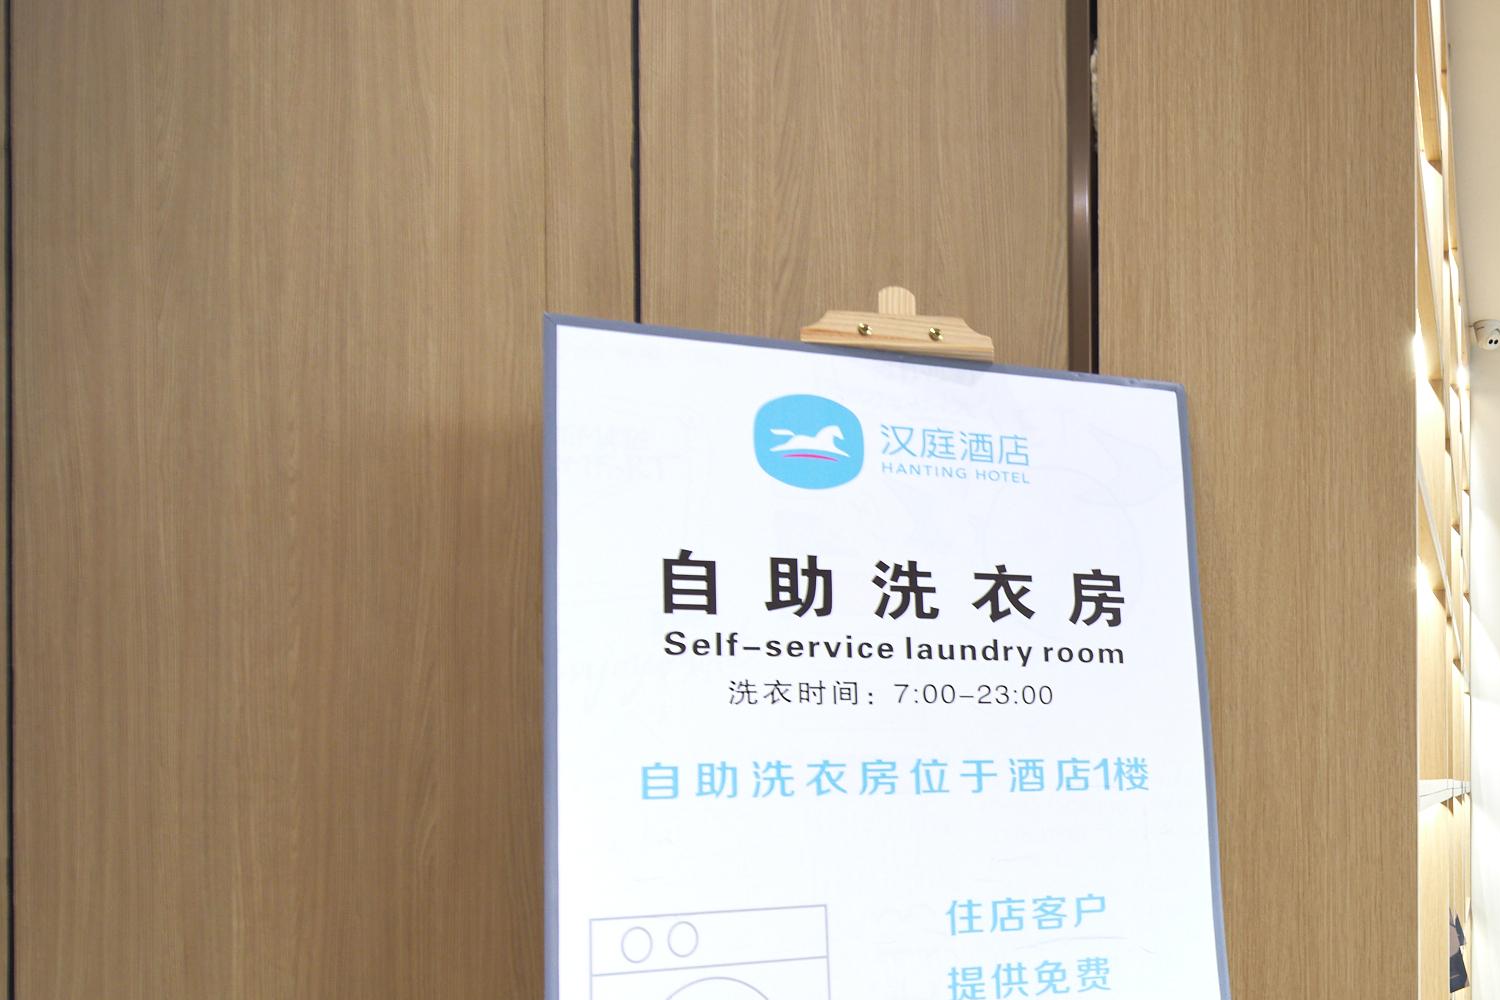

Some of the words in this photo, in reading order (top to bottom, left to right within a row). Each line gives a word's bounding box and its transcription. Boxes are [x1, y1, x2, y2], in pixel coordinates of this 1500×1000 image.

[880, 423, 1030, 466] 汉庭酒店
[881, 461, 967, 480] HANTING
[975, 469, 1031, 485] HOTEL
[662, 548, 1125, 627] 自助洗衣房
[664, 630, 895, 660] Self-service
[904, 636, 1033, 668] laundry
[1043, 643, 1124, 665] room
[641, 756, 1149, 801] 自助洗衣房位于酒店1楼
[946, 893, 1106, 936] 住店客户
